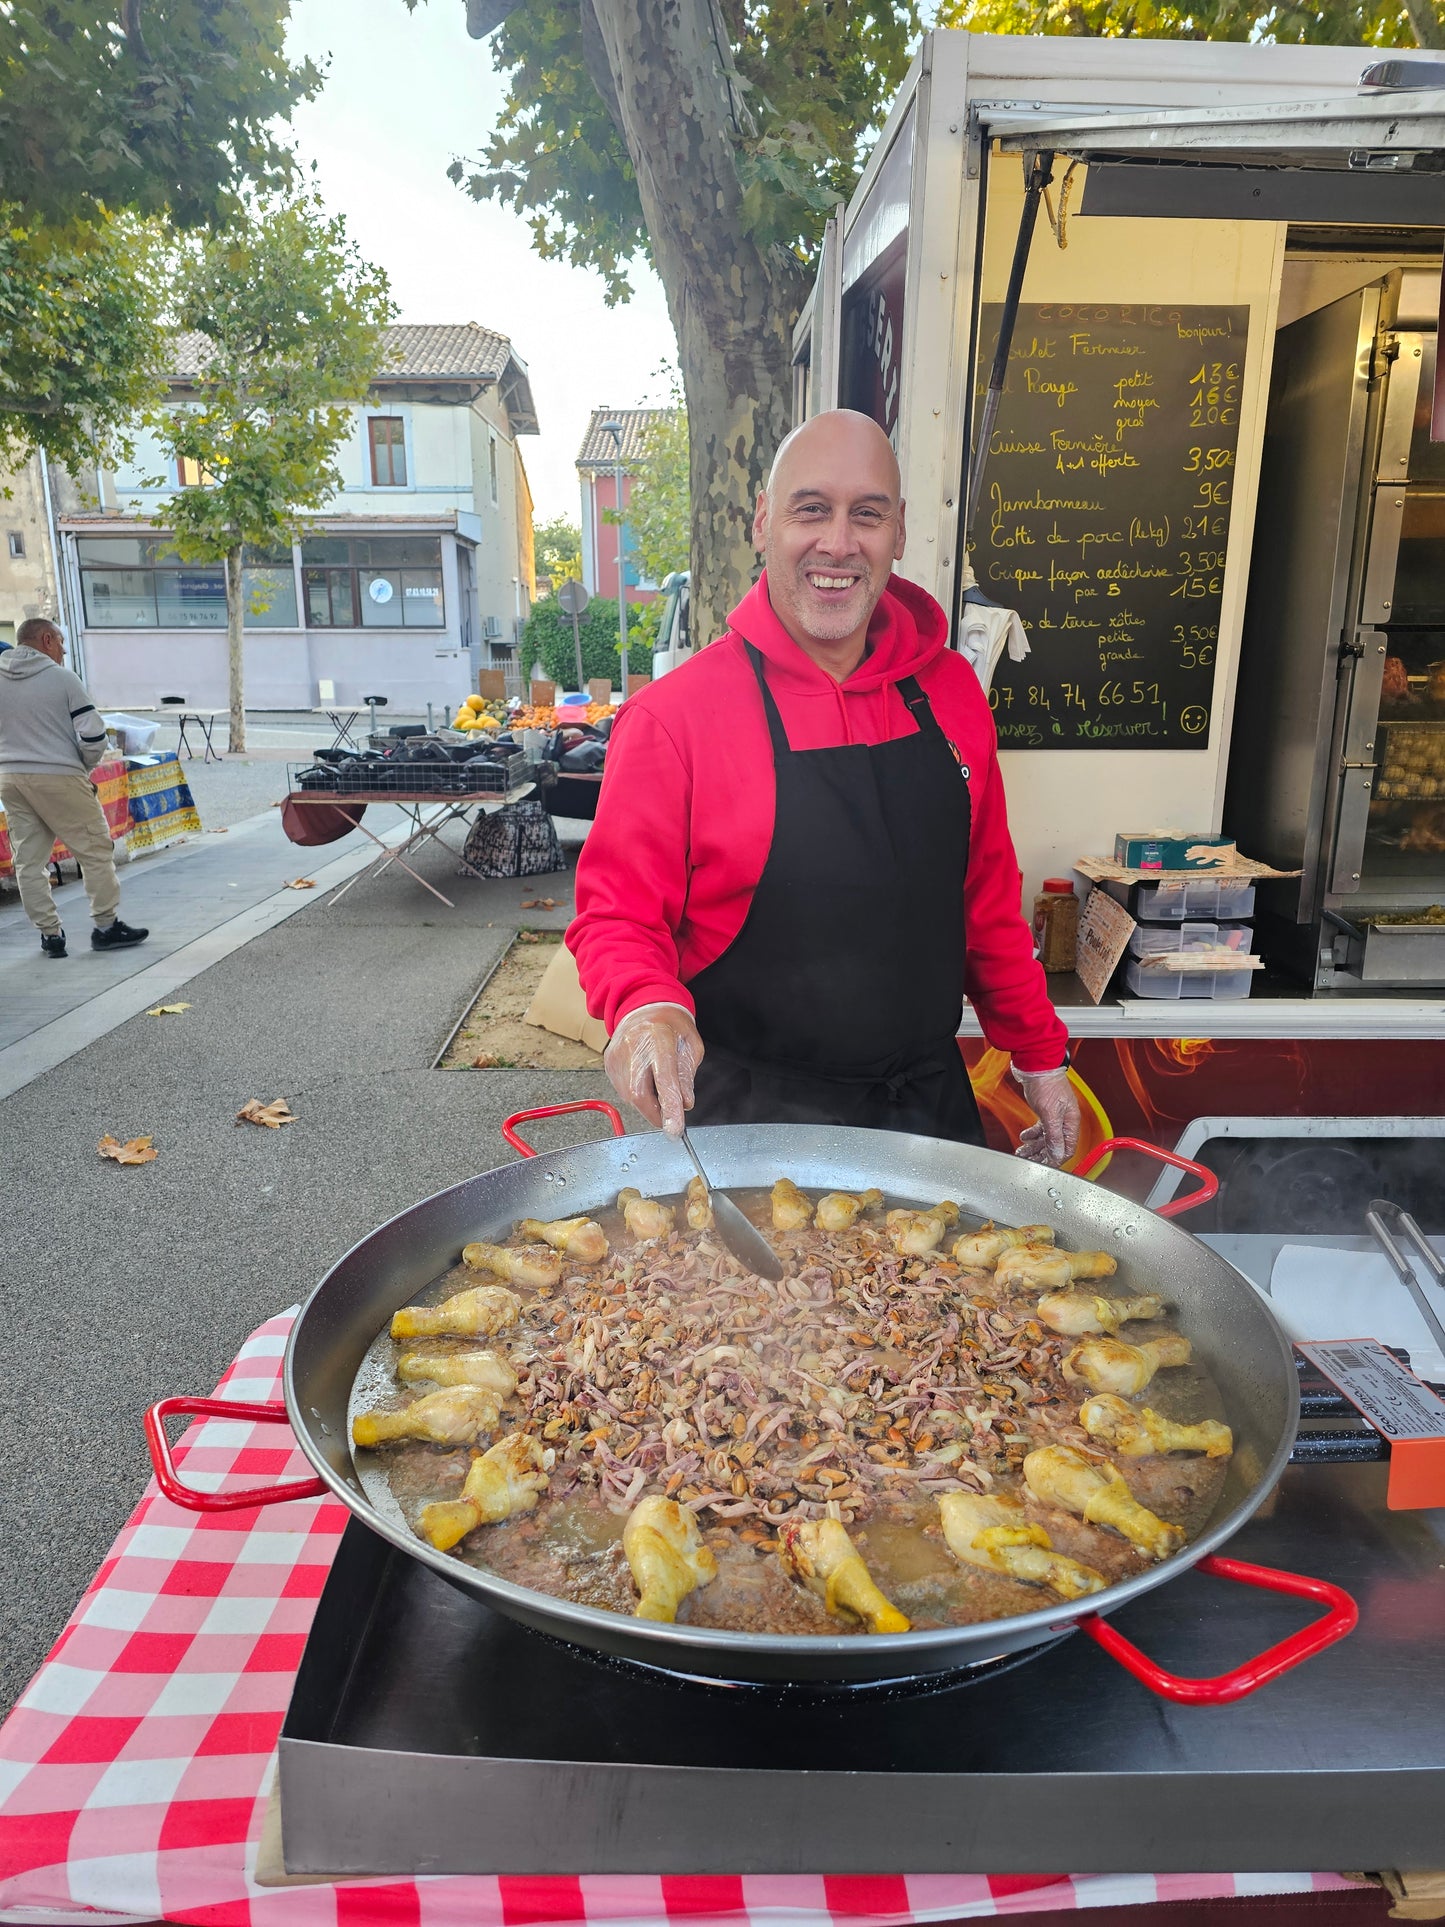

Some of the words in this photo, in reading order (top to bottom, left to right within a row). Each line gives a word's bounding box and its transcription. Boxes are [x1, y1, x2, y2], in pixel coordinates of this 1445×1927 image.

[1069, 333, 1146, 355] Fermier
[1024, 367, 1079, 408] Rouge
[1113, 370, 1155, 400] petit
[1189, 363, 1240, 384] 13€
[1113, 399, 1160, 418] moyen
[1189, 385, 1238, 407] 16€
[1189, 407, 1238, 428] 20€
[989, 431, 1046, 455] Cuisse
[1090, 452, 1141, 477] offerte
[991, 482, 1105, 528] Jambonneau
[1193, 481, 1230, 508] 9€
[1046, 521, 1070, 544] de
[1077, 532, 1124, 560] porc
[1047, 559, 1090, 591] façon
[1075, 588, 1099, 604] par
[1107, 583, 1121, 597] 5
[1170, 577, 1222, 599] 15€
[1039, 607, 1058, 629] de
[1060, 611, 1101, 629] terre
[1098, 630, 1135, 649] petite
[1100, 648, 1145, 672] grande
[1180, 646, 1213, 669] 5€
[987, 687, 1015, 710] 07
[1028, 685, 1050, 711] 84
[1061, 683, 1086, 711] 74
[997, 724, 1043, 745] nsez
[1050, 715, 1065, 736] à
